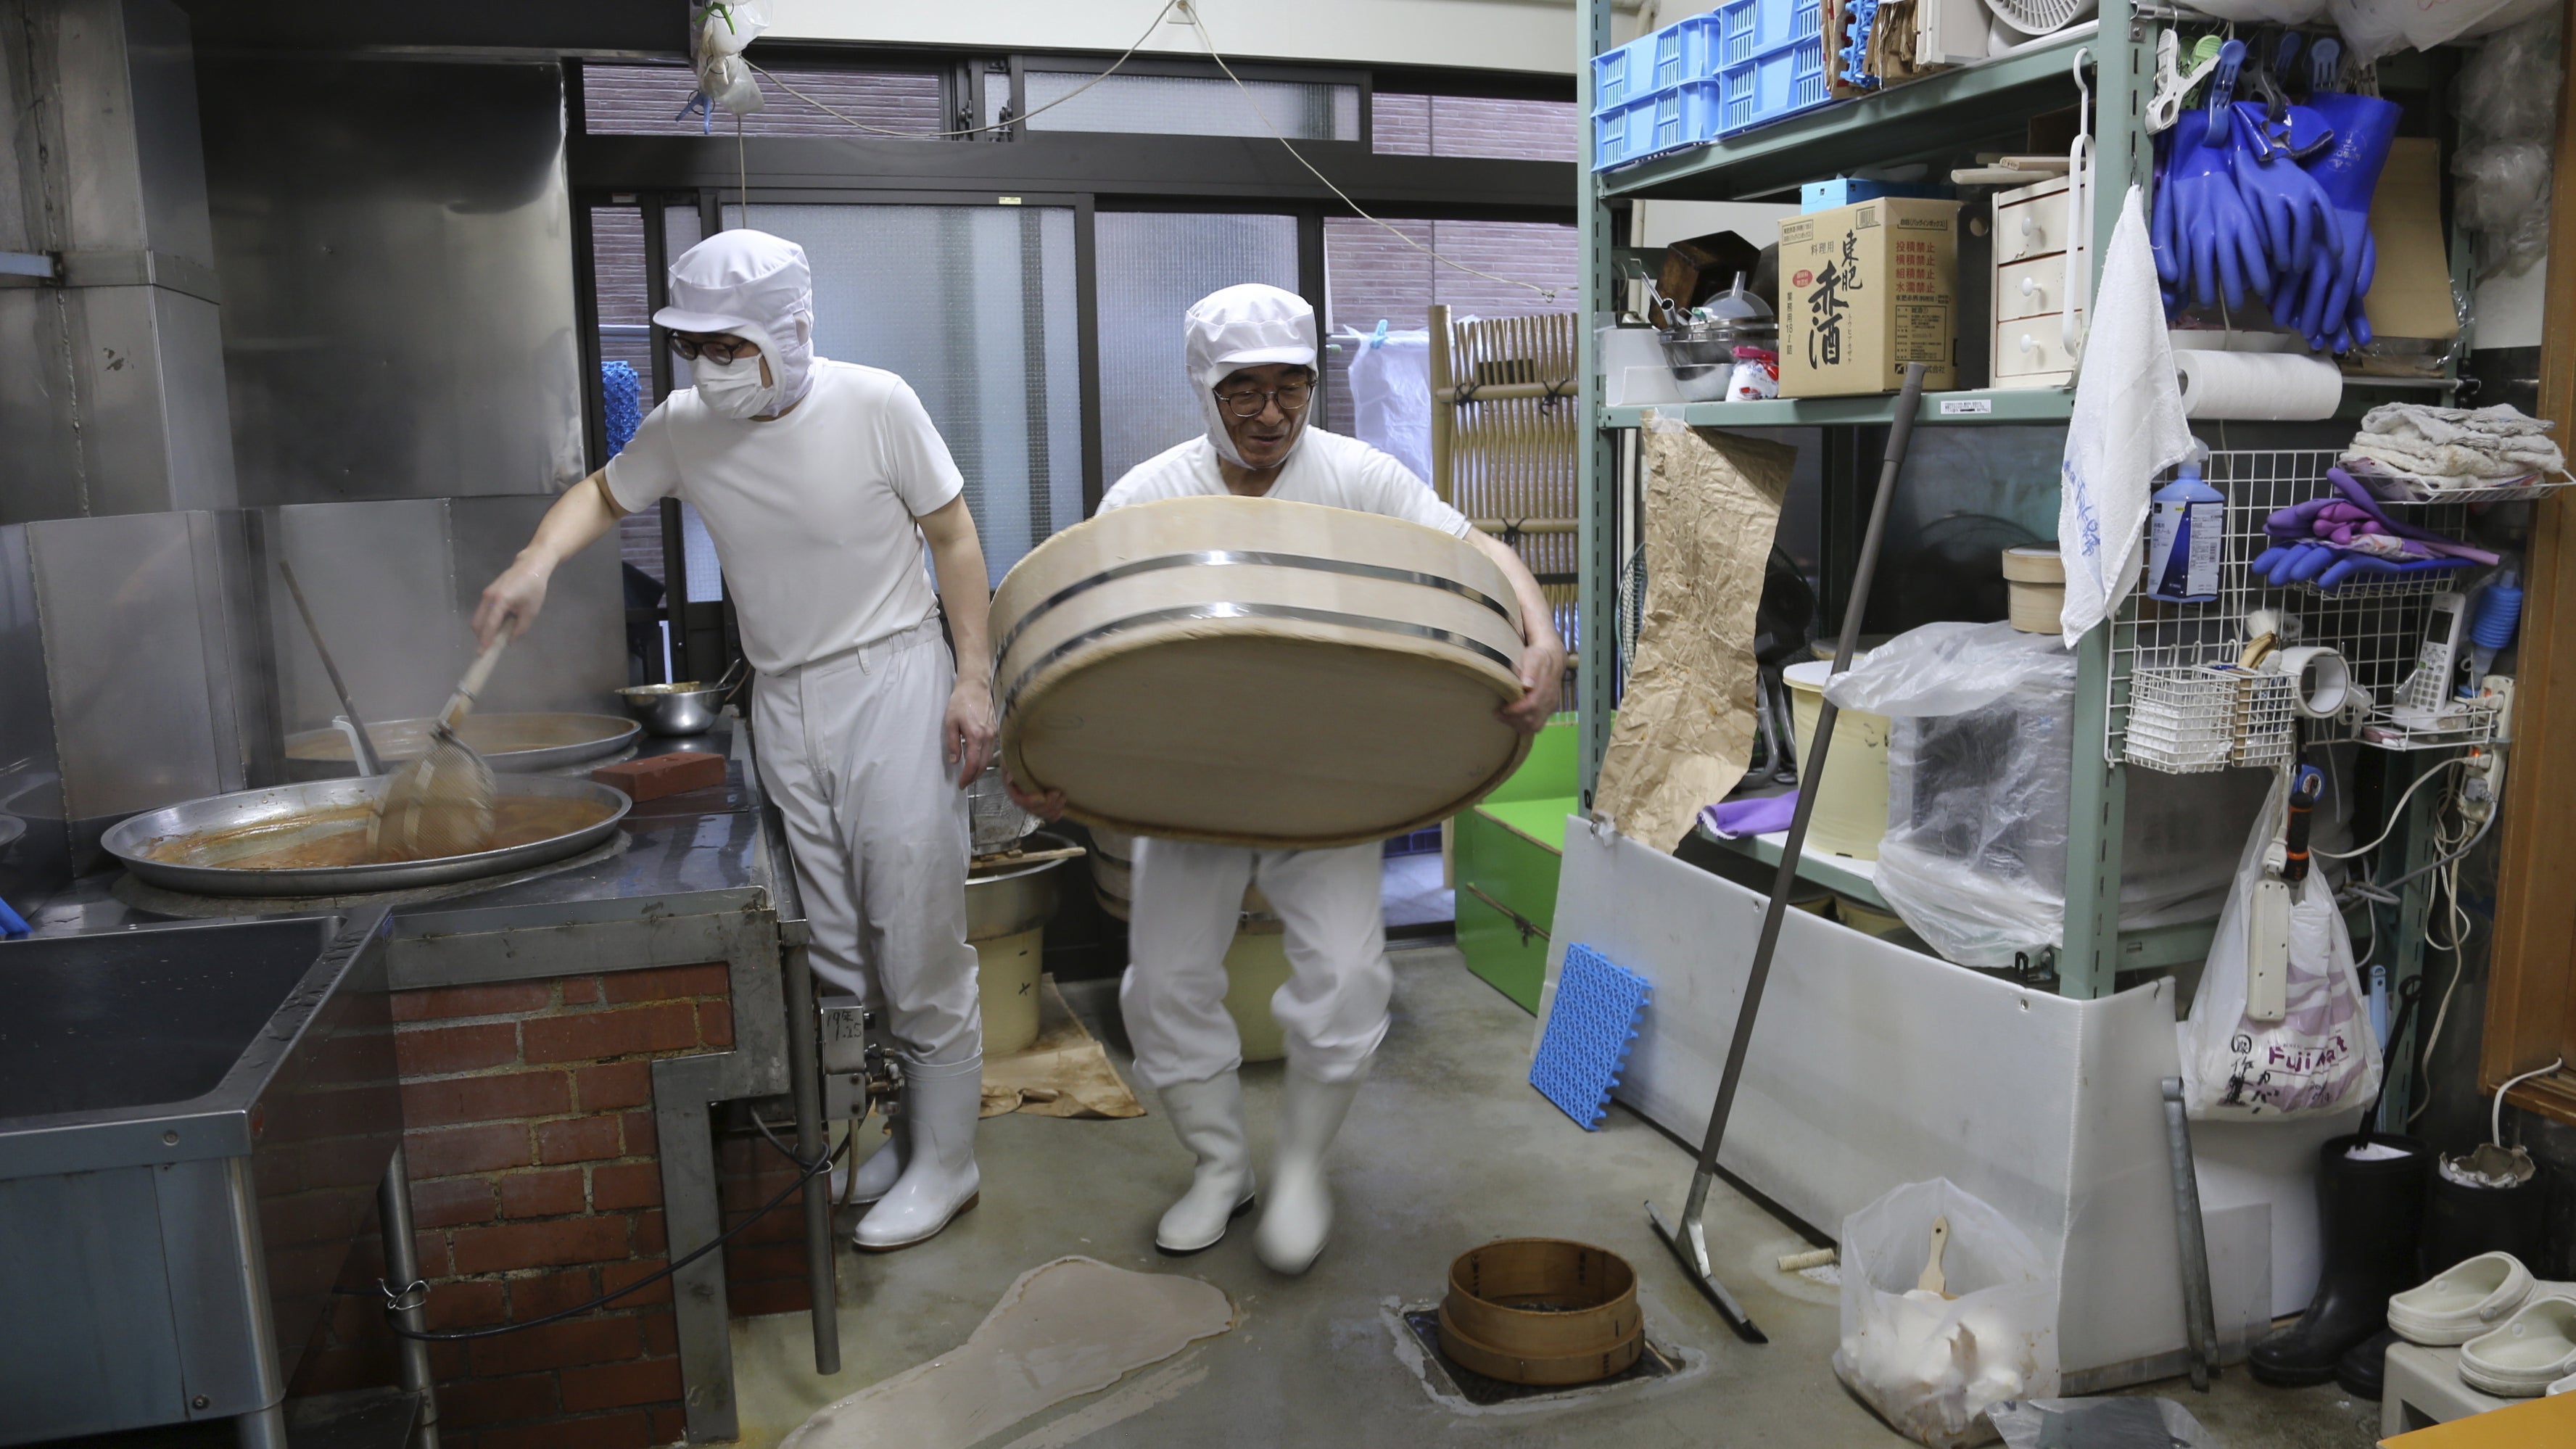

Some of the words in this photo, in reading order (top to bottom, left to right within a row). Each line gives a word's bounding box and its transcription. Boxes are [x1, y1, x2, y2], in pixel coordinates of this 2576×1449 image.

[1811, 241, 1834, 256] 料理用
[1896, 241, 1936, 253] 投積禁止
[1841, 228, 1863, 292] 東肥
[1896, 254, 1936, 266] 横積禁止
[1896, 267, 1936, 280] 組積禁止
[1896, 281, 1936, 294] 水濡禁止
[1808, 260, 1849, 370] 赤酒
